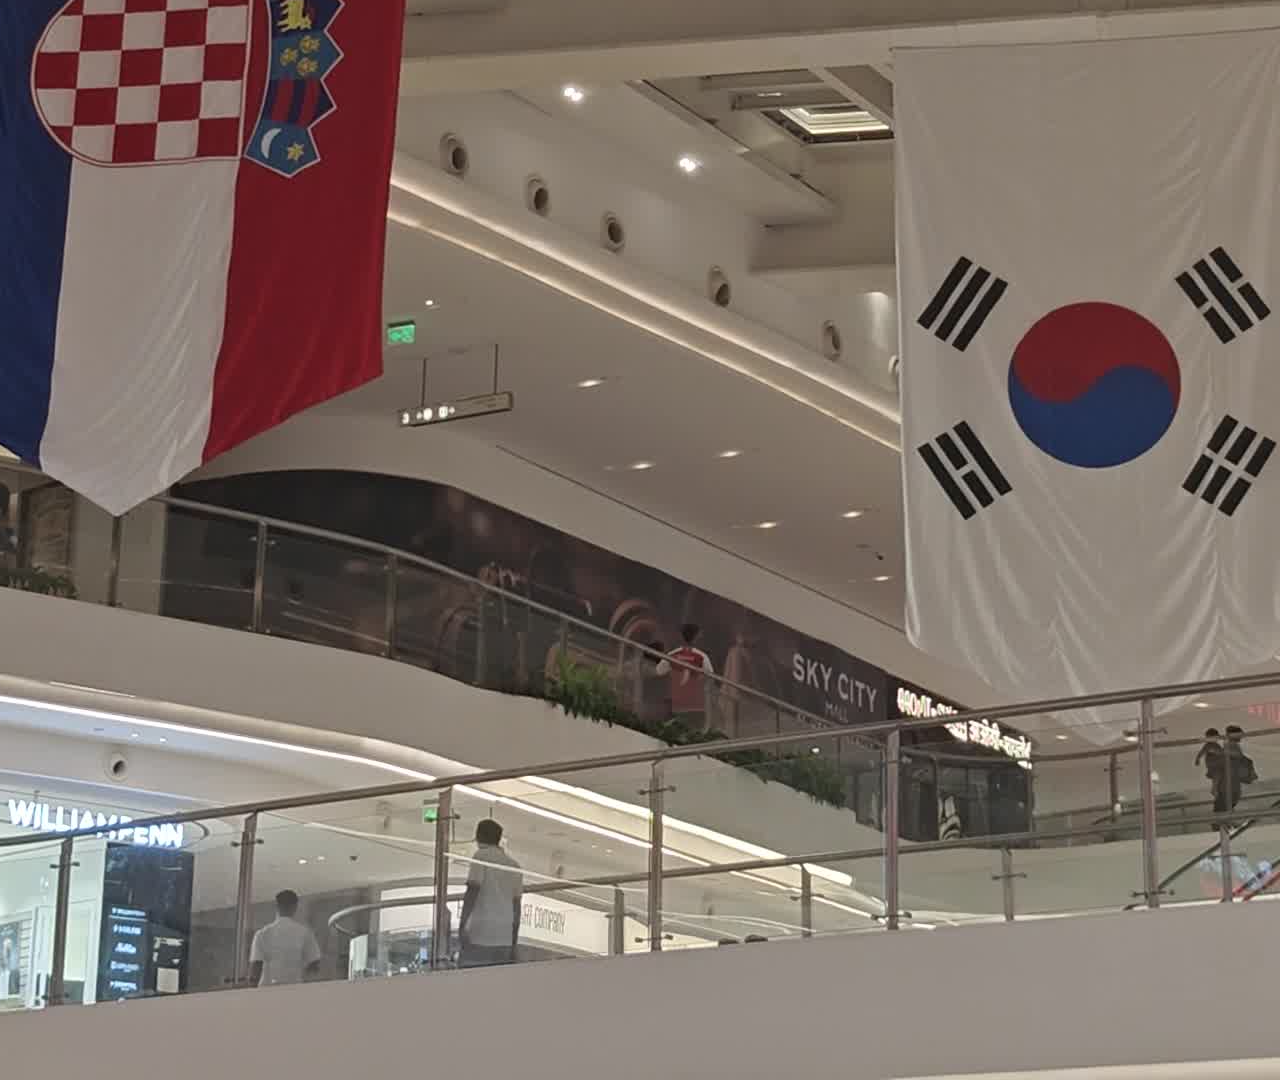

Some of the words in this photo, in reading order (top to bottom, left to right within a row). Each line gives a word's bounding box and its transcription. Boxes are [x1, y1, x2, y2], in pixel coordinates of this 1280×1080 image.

[792, 652, 833, 693] SKY
[837, 672, 878, 714] CITY
[534, 905, 566, 935] COMPANY
